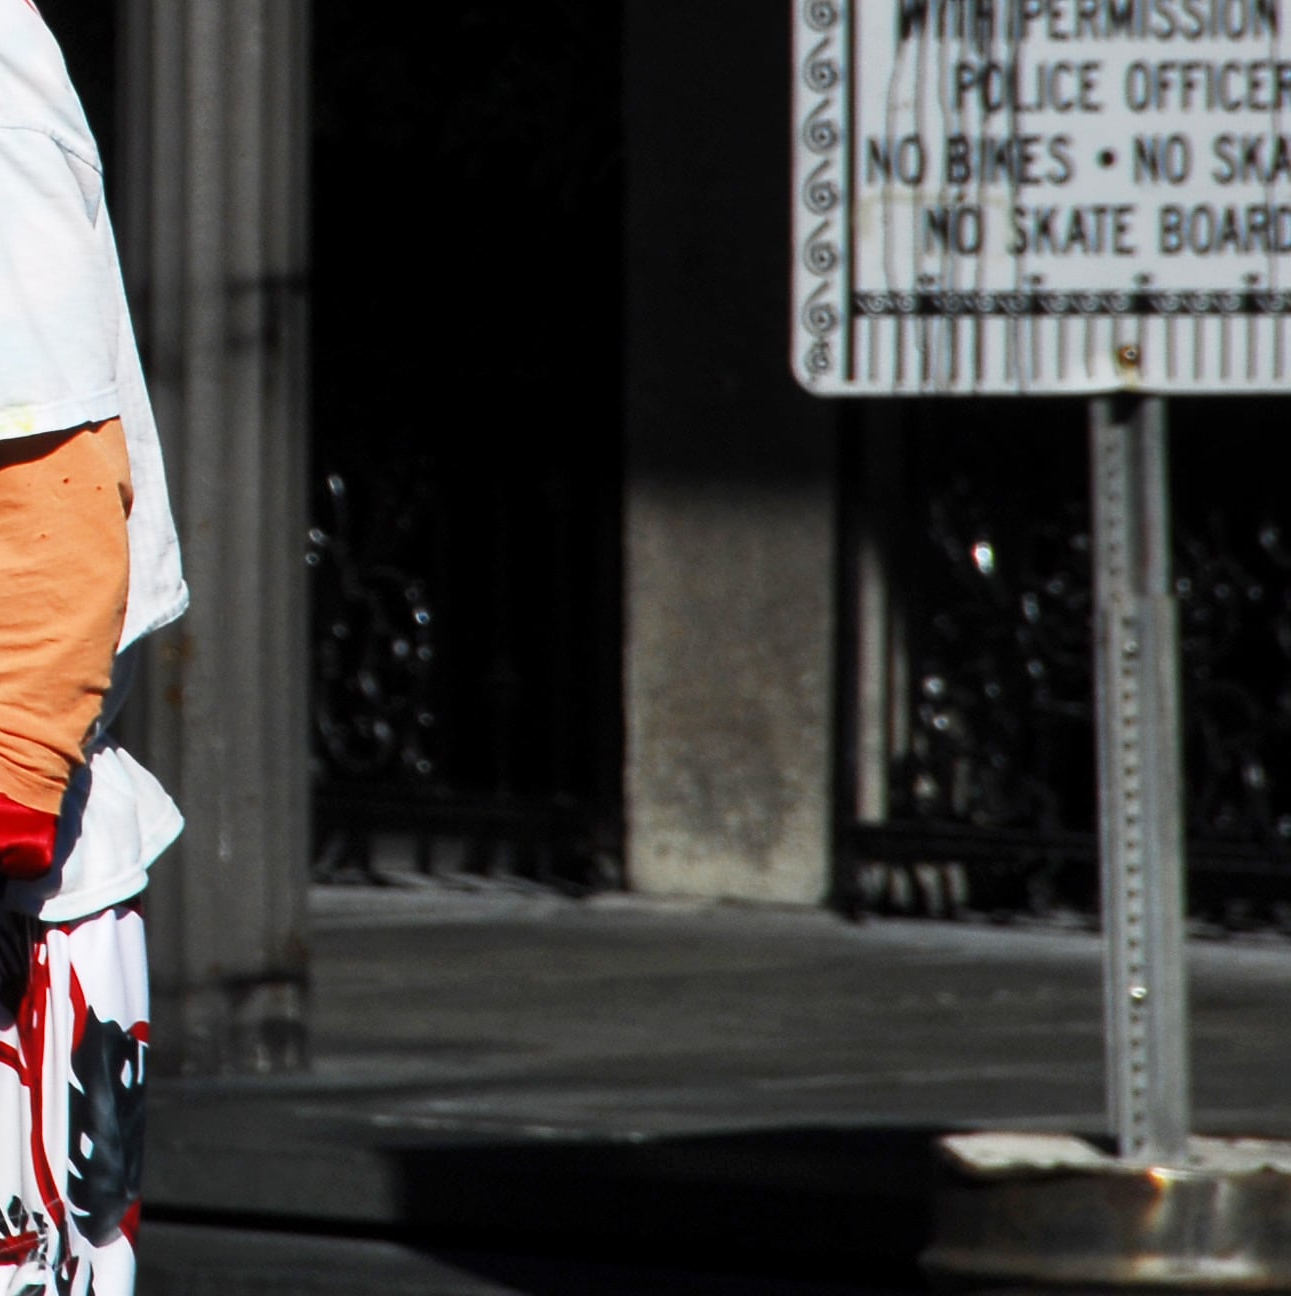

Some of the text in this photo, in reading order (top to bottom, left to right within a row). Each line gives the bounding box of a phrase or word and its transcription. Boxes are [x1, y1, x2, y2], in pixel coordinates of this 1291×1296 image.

[955, 60, 1102, 112] POLICE
[866, 134, 925, 187] NO
[946, 134, 1073, 187] BIKES
[1133, 134, 1190, 187] NO
[923, 207, 983, 256] NO
[1007, 207, 1137, 256] SKATE
